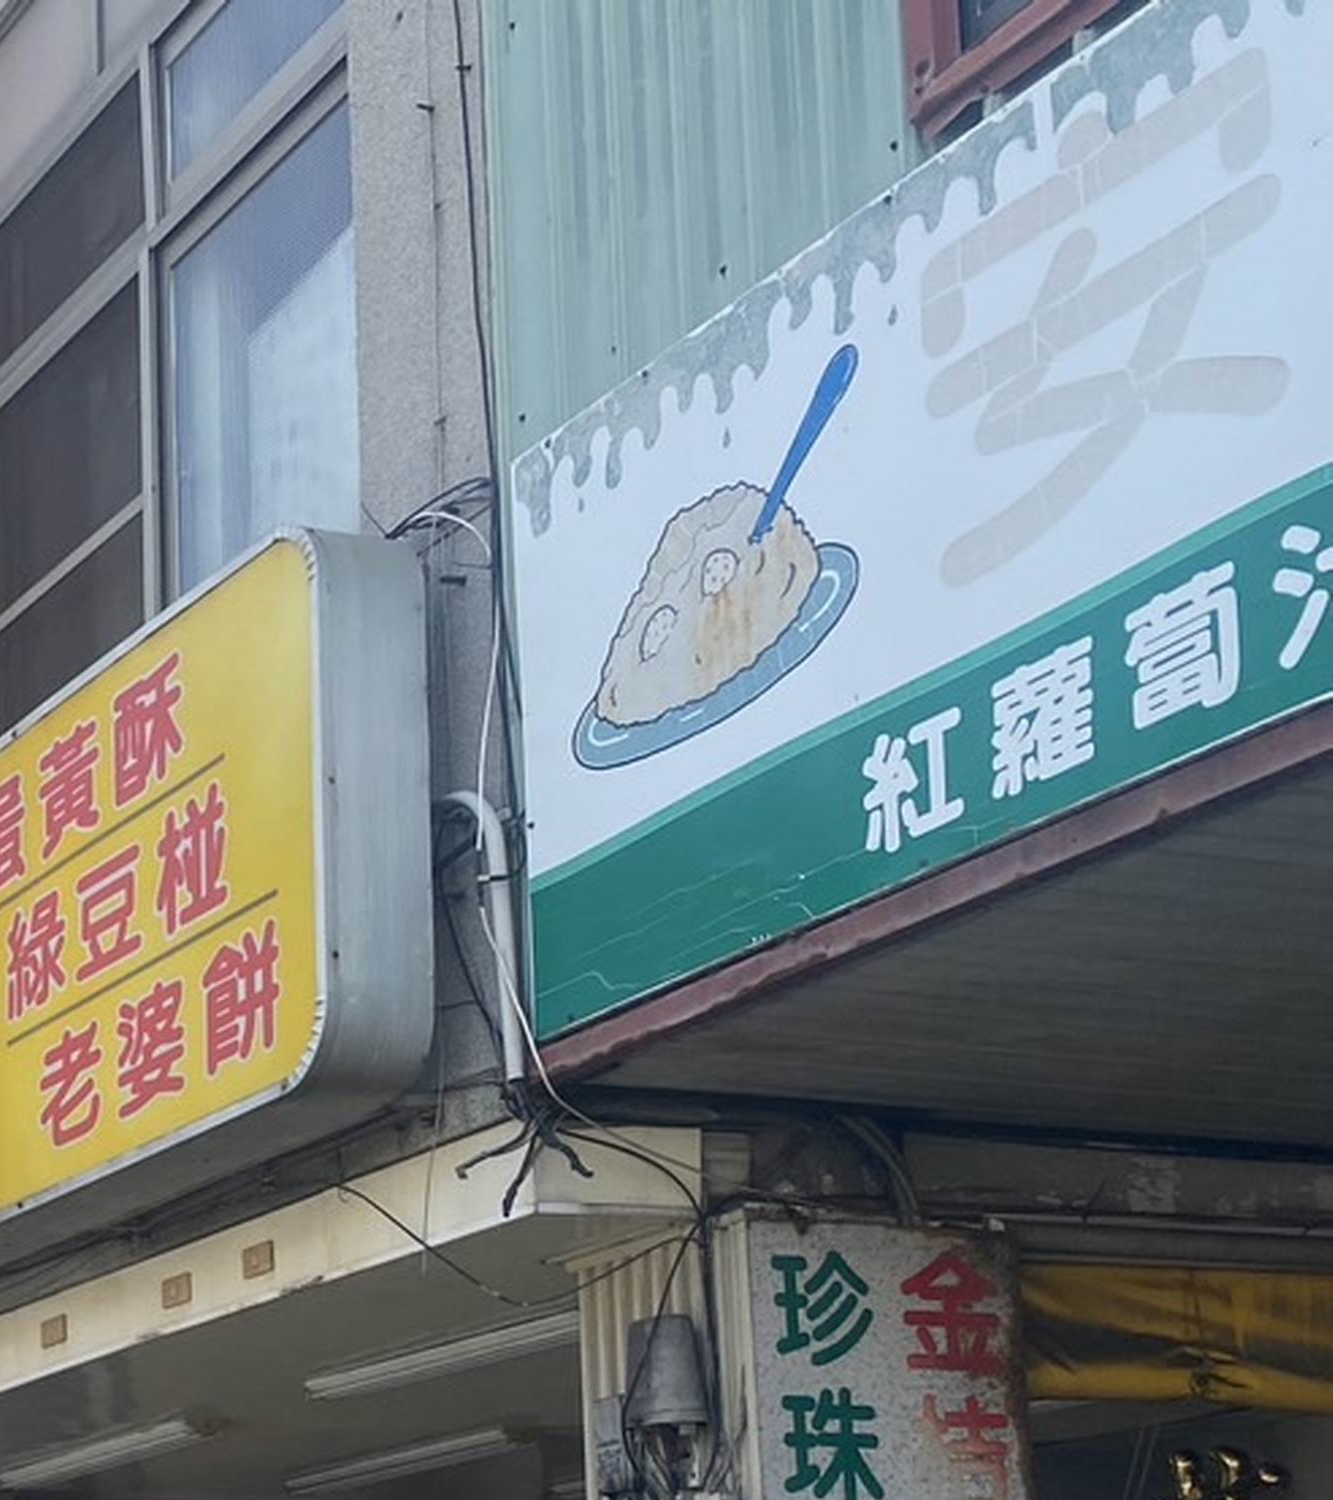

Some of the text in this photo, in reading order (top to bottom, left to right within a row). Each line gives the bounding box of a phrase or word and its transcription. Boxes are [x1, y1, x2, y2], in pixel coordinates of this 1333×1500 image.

[4, 782, 229, 1022] 綠豆椪
[38, 919, 284, 1150] 老婆餅
